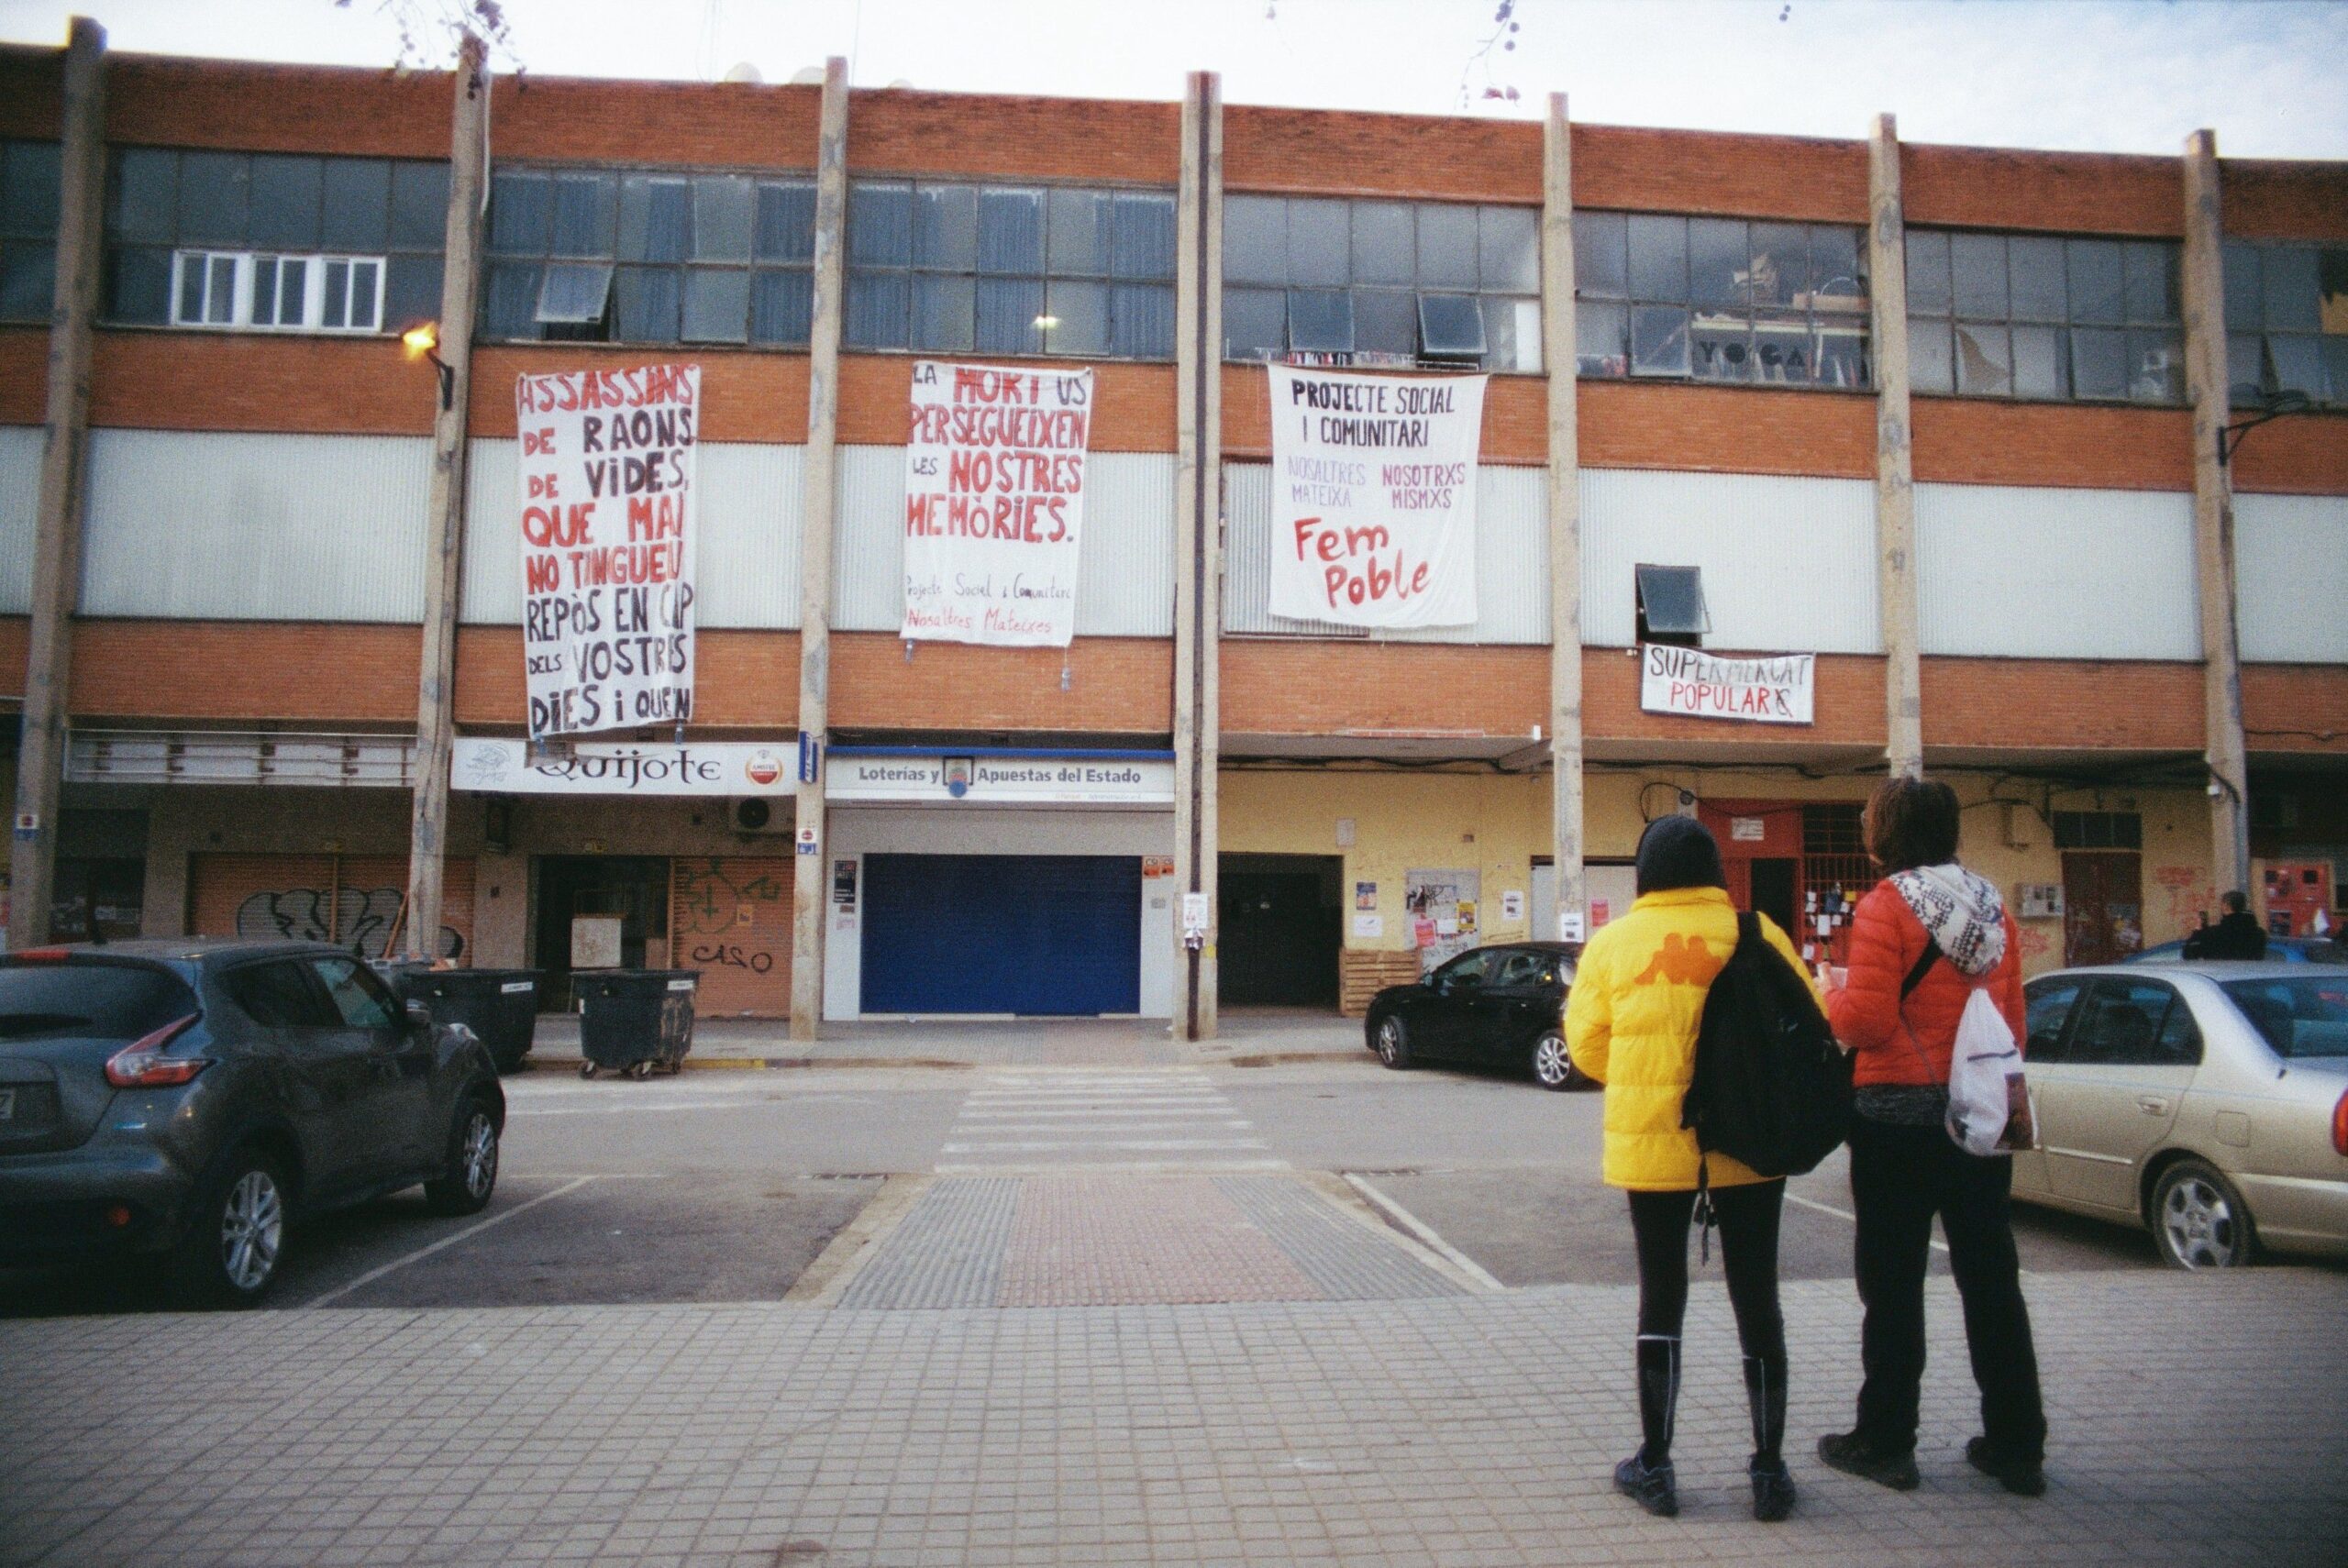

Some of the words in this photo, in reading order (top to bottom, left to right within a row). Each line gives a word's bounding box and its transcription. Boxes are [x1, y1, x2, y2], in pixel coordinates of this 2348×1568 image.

[518, 365, 693, 413] ASSASSINS
[913, 364, 936, 384] LA
[1057, 376, 1086, 405] US
[1291, 378, 1388, 413] PROJECTE
[1395, 385, 1455, 414] SOCIAL
[523, 427, 556, 457] DE
[583, 407, 692, 453] RAONS
[1321, 416, 1429, 447] COMUNITARI
[528, 473, 559, 499] DE
[914, 457, 937, 475] LES
[949, 449, 1082, 493] NOSTRES
[1288, 456, 1366, 485] NOSALTRES
[1382, 462, 1466, 487] NOSOTRXS
[1292, 484, 1352, 507] MATEIXA
[1391, 488, 1453, 509] MISMXS
[522, 502, 596, 547] QUE
[1294, 517, 1390, 561] Fem
[526, 554, 559, 594] NO
[568, 541, 682, 589] TINGUEU
[955, 572, 991, 597] Social
[1325, 549, 1431, 608] Poble
[615, 587, 648, 632] EN
[907, 606, 972, 629] Nosaltres
[984, 608, 1052, 633] Mateixes
[528, 654, 561, 675] DELS
[574, 634, 687, 683] VOSTRES
[1651, 647, 1811, 685] SUPERMERCAT
[858, 765, 925, 780] Loterías
[931, 768, 939, 784] y
[978, 767, 1052, 784] Apuestas
[1058, 767, 1080, 781] del
[1086, 767, 1141, 783] Estado
